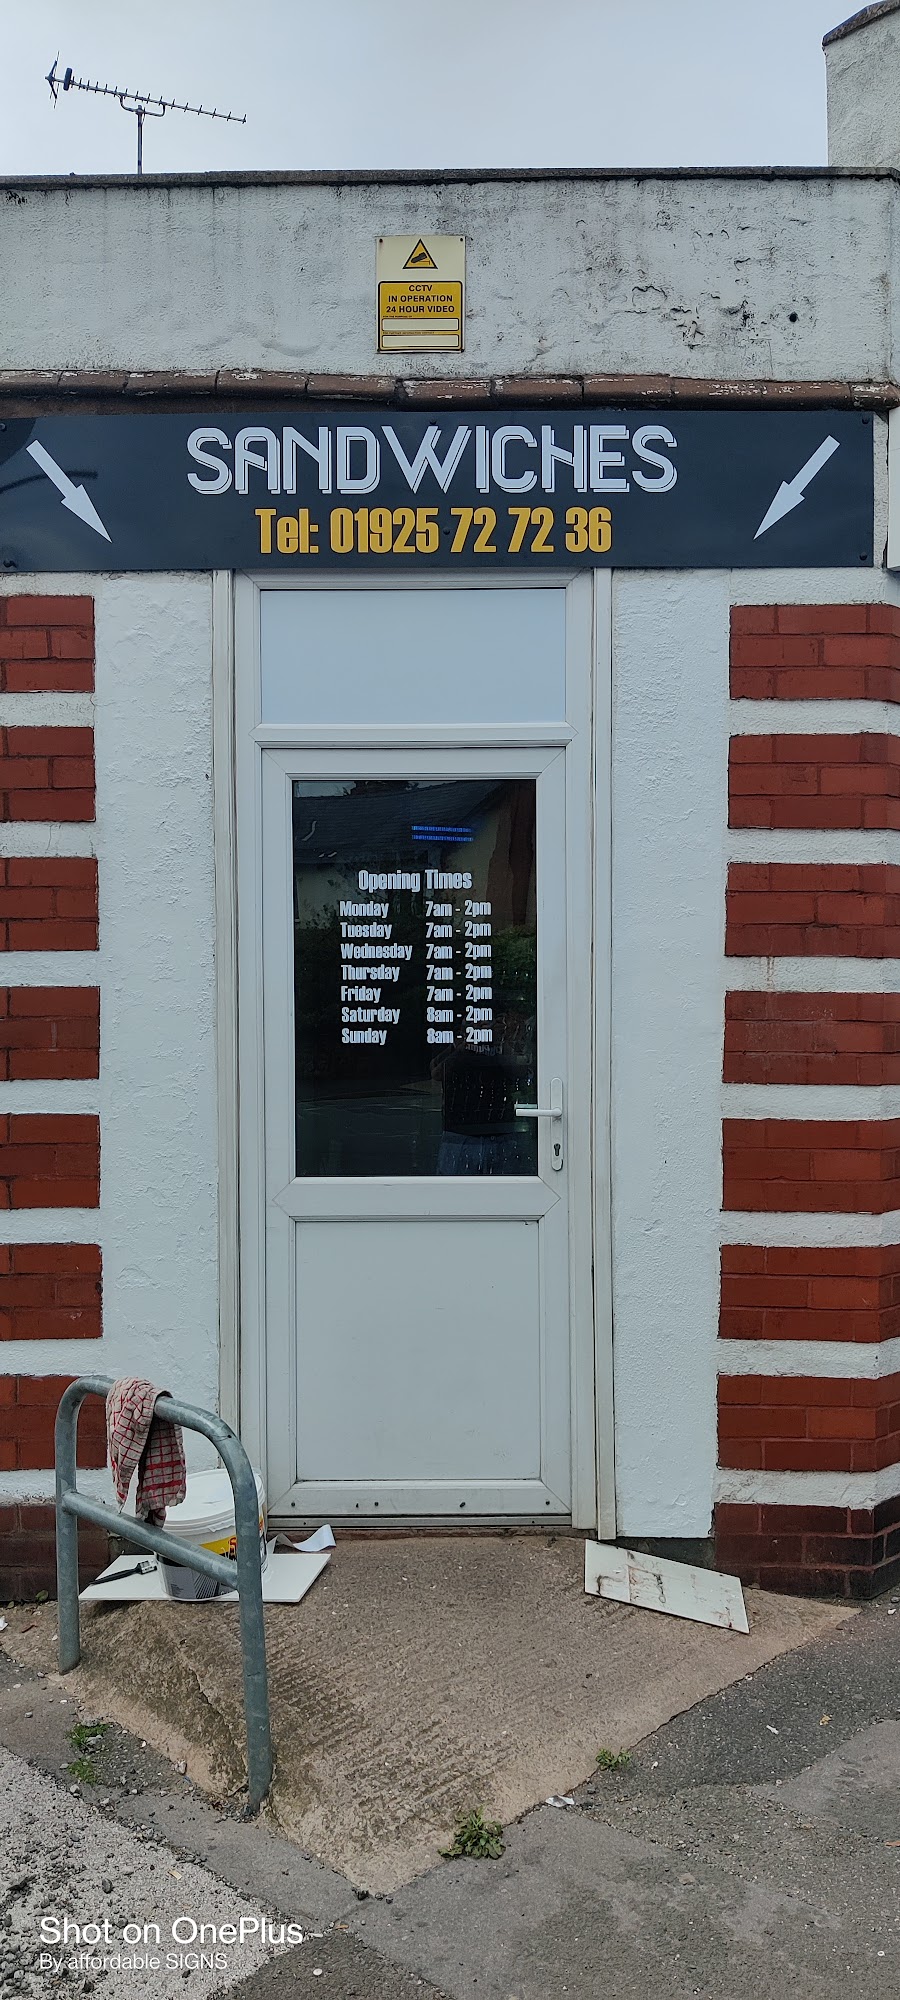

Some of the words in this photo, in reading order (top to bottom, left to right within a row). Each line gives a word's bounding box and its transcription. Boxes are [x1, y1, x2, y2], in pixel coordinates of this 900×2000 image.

[408, 284, 433, 292] CCTV
[386, 305, 397, 313] 24
[399, 305, 425, 313] HOUR
[427, 305, 455, 313] VIDEO
[388, 295, 398, 303] IN
[400, 295, 453, 303] OPERATION
[187, 425, 678, 495] SANDWICHES
[256, 509, 319, 554] Tel:
[331, 508, 439, 554] 01925
[451, 507, 497, 553] 72
[509, 507, 554, 553] 72
[565, 506, 612, 553] 36
[358, 869, 421, 894] Opening
[425, 869, 473, 890] Times
[340, 900, 390, 919] Monday
[426, 901, 452, 916] 7am
[464, 899, 492, 918] 2pm
[340, 921, 393, 940] Tuesday
[426, 922, 452, 938] 7am
[464, 921, 492, 939] 2pm
[340, 942, 413, 961] Wednesday
[426, 944, 453, 959] 7am
[464, 942, 492, 961] 2pm
[341, 964, 401, 983] Thursday
[426, 965, 453, 980] 7am
[465, 963, 492, 982] 2pm
[341, 985, 382, 1004] Friday
[427, 986, 453, 1001] 7am
[465, 984, 493, 1003] 2pm
[341, 1007, 401, 1025] Saturday
[427, 1007, 453, 1022] 8am
[465, 1005, 493, 1024] 2pm
[341, 1027, 388, 1046] Sunday
[427, 1028, 453, 1043] 8am
[465, 1026, 493, 1045] 2pm
